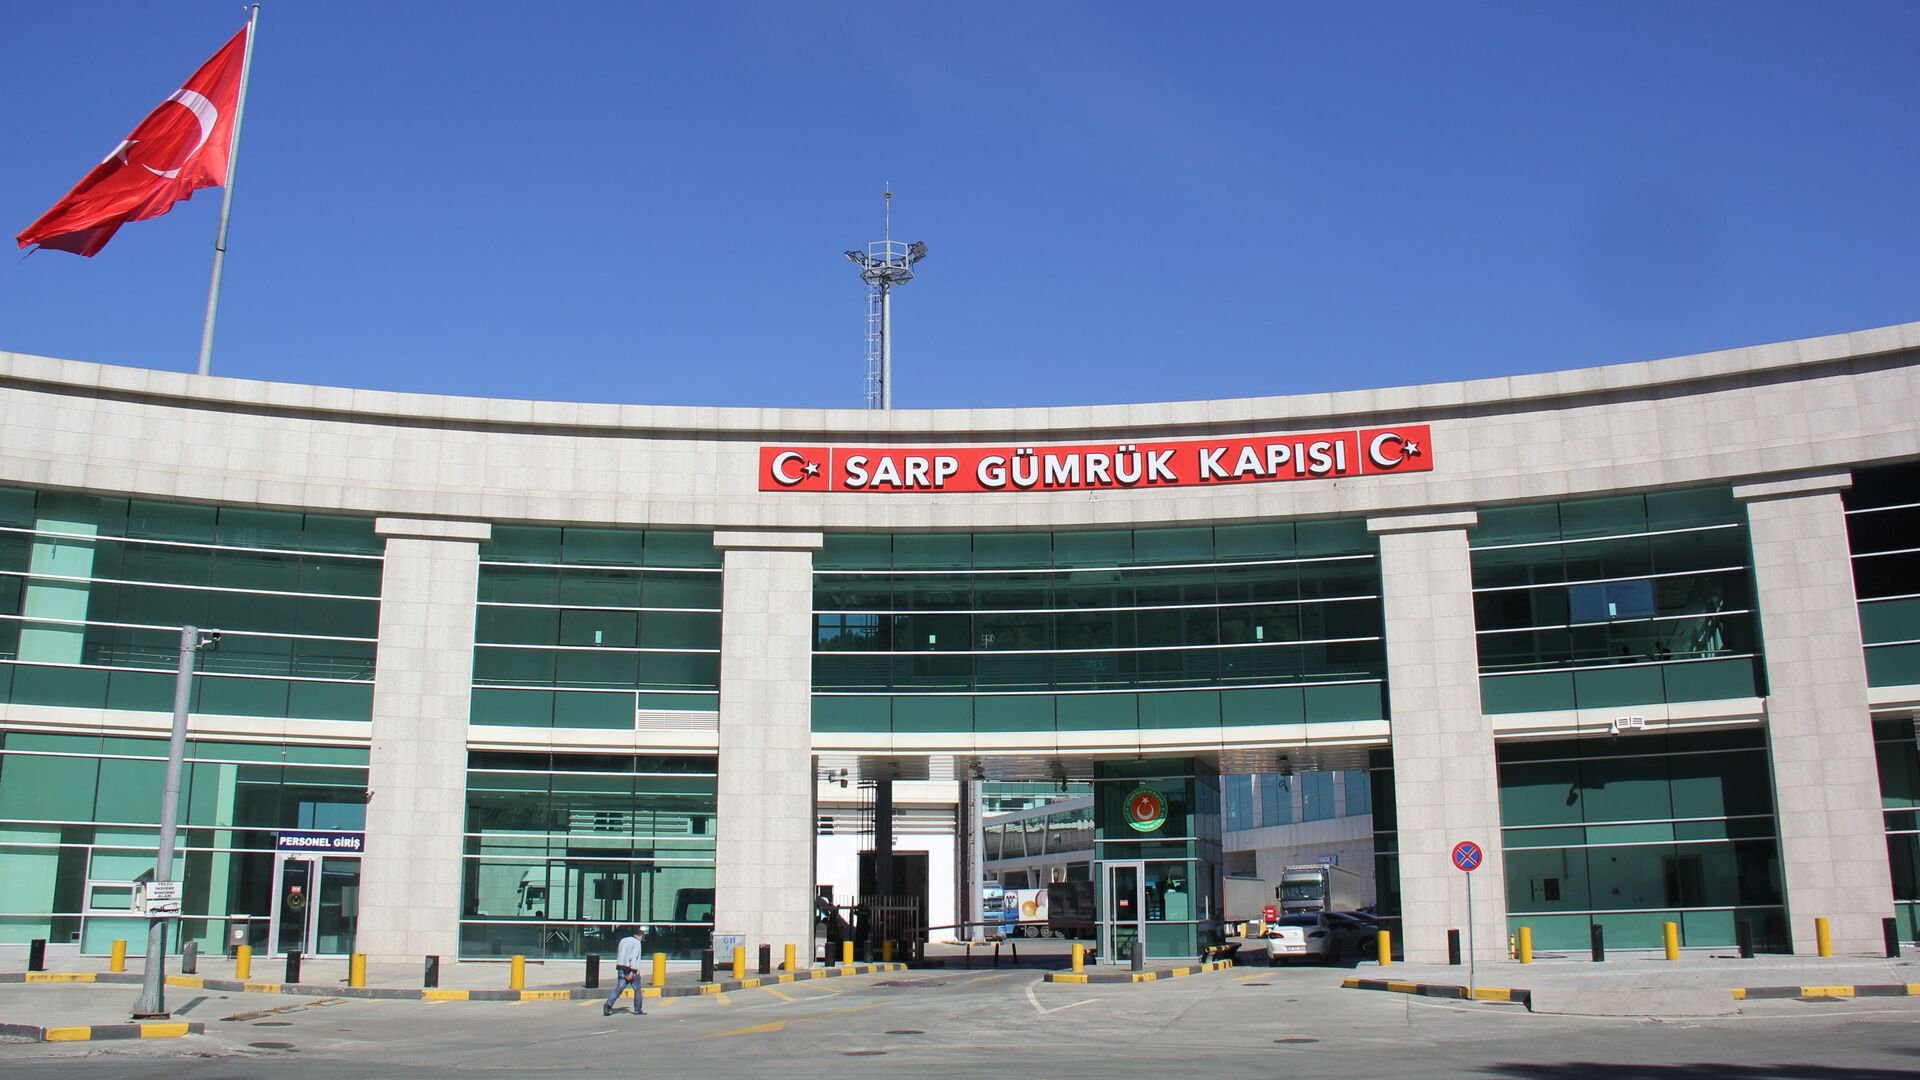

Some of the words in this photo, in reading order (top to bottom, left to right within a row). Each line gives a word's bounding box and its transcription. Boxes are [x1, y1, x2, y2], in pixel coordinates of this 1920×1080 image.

[844, 455, 959, 489] SARP
[976, 445, 1179, 490] GÜMRÜK
[1199, 440, 1347, 480] KAPISI
[280, 836, 331, 847] PERSONEL
[333, 837, 360, 849] GİRİŞ
